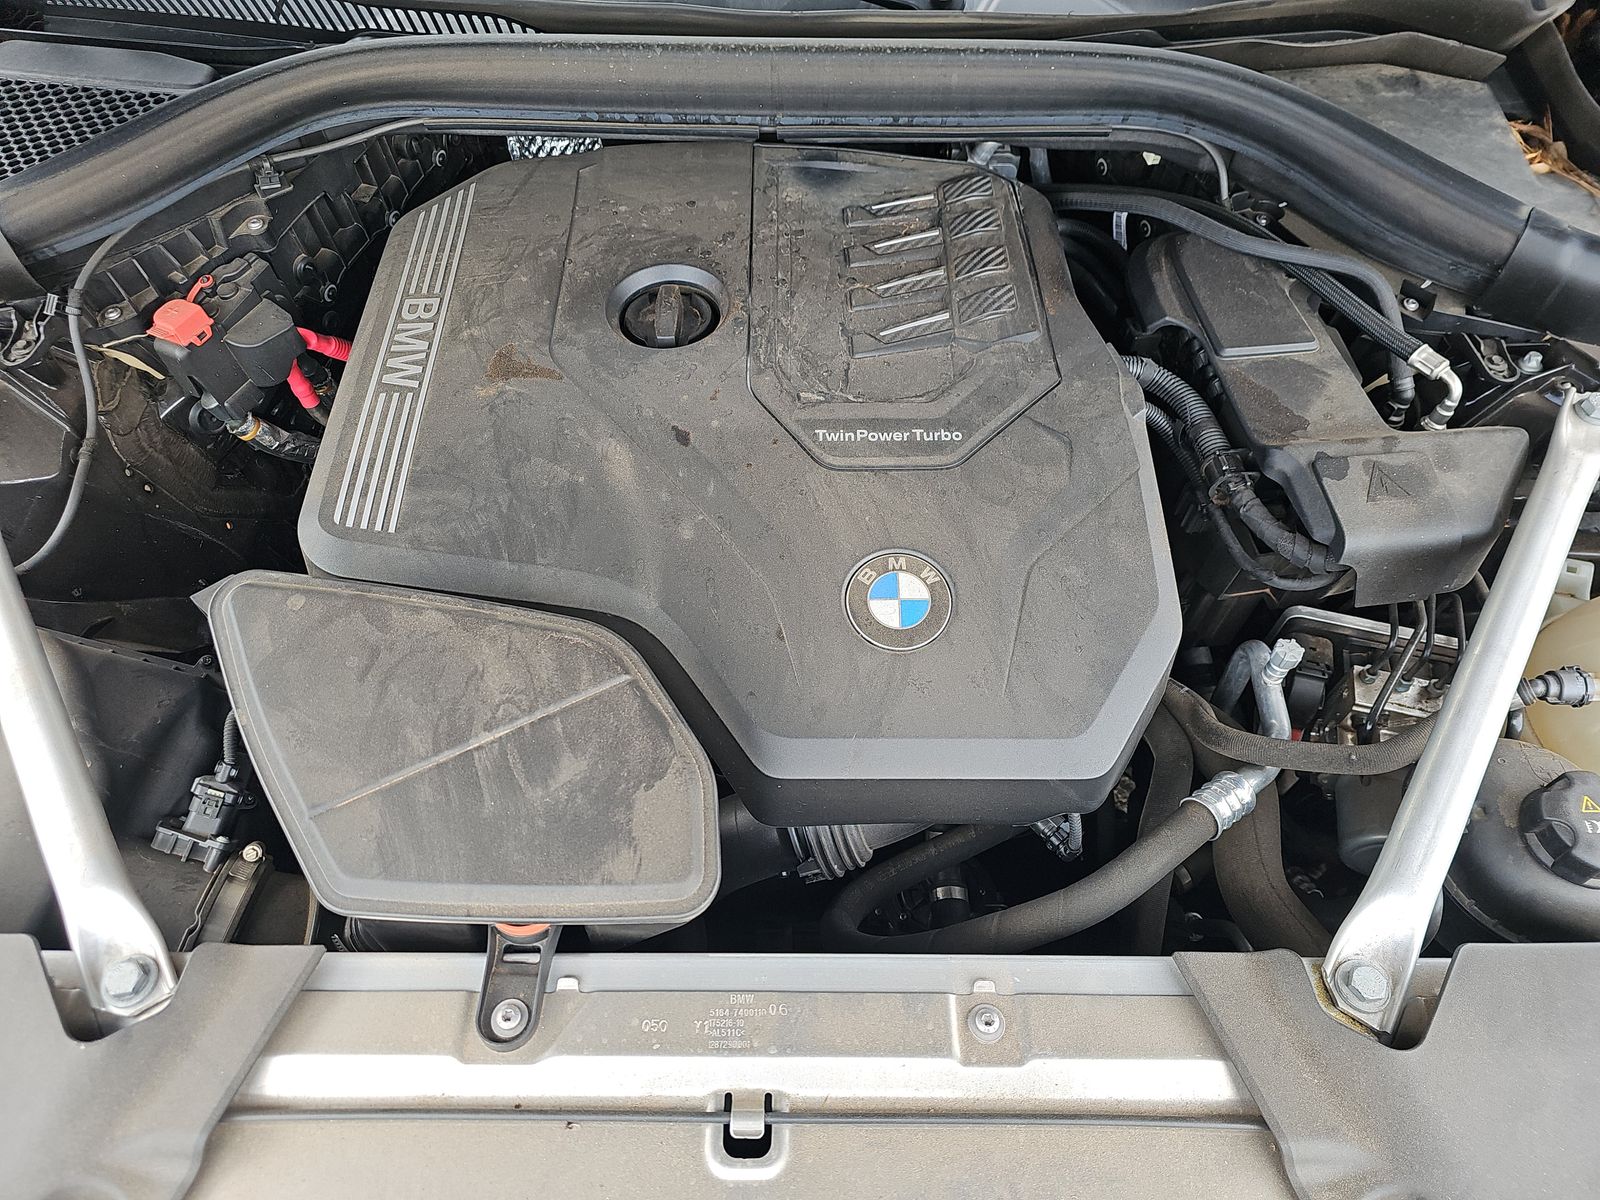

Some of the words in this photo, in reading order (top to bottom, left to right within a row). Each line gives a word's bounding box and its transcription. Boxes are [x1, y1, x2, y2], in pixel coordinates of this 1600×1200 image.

[381, 297, 441, 388] BMW
[912, 429, 962, 441] Turbo
[857, 556, 941, 586] BMW
[730, 994, 754, 1005] BMW
